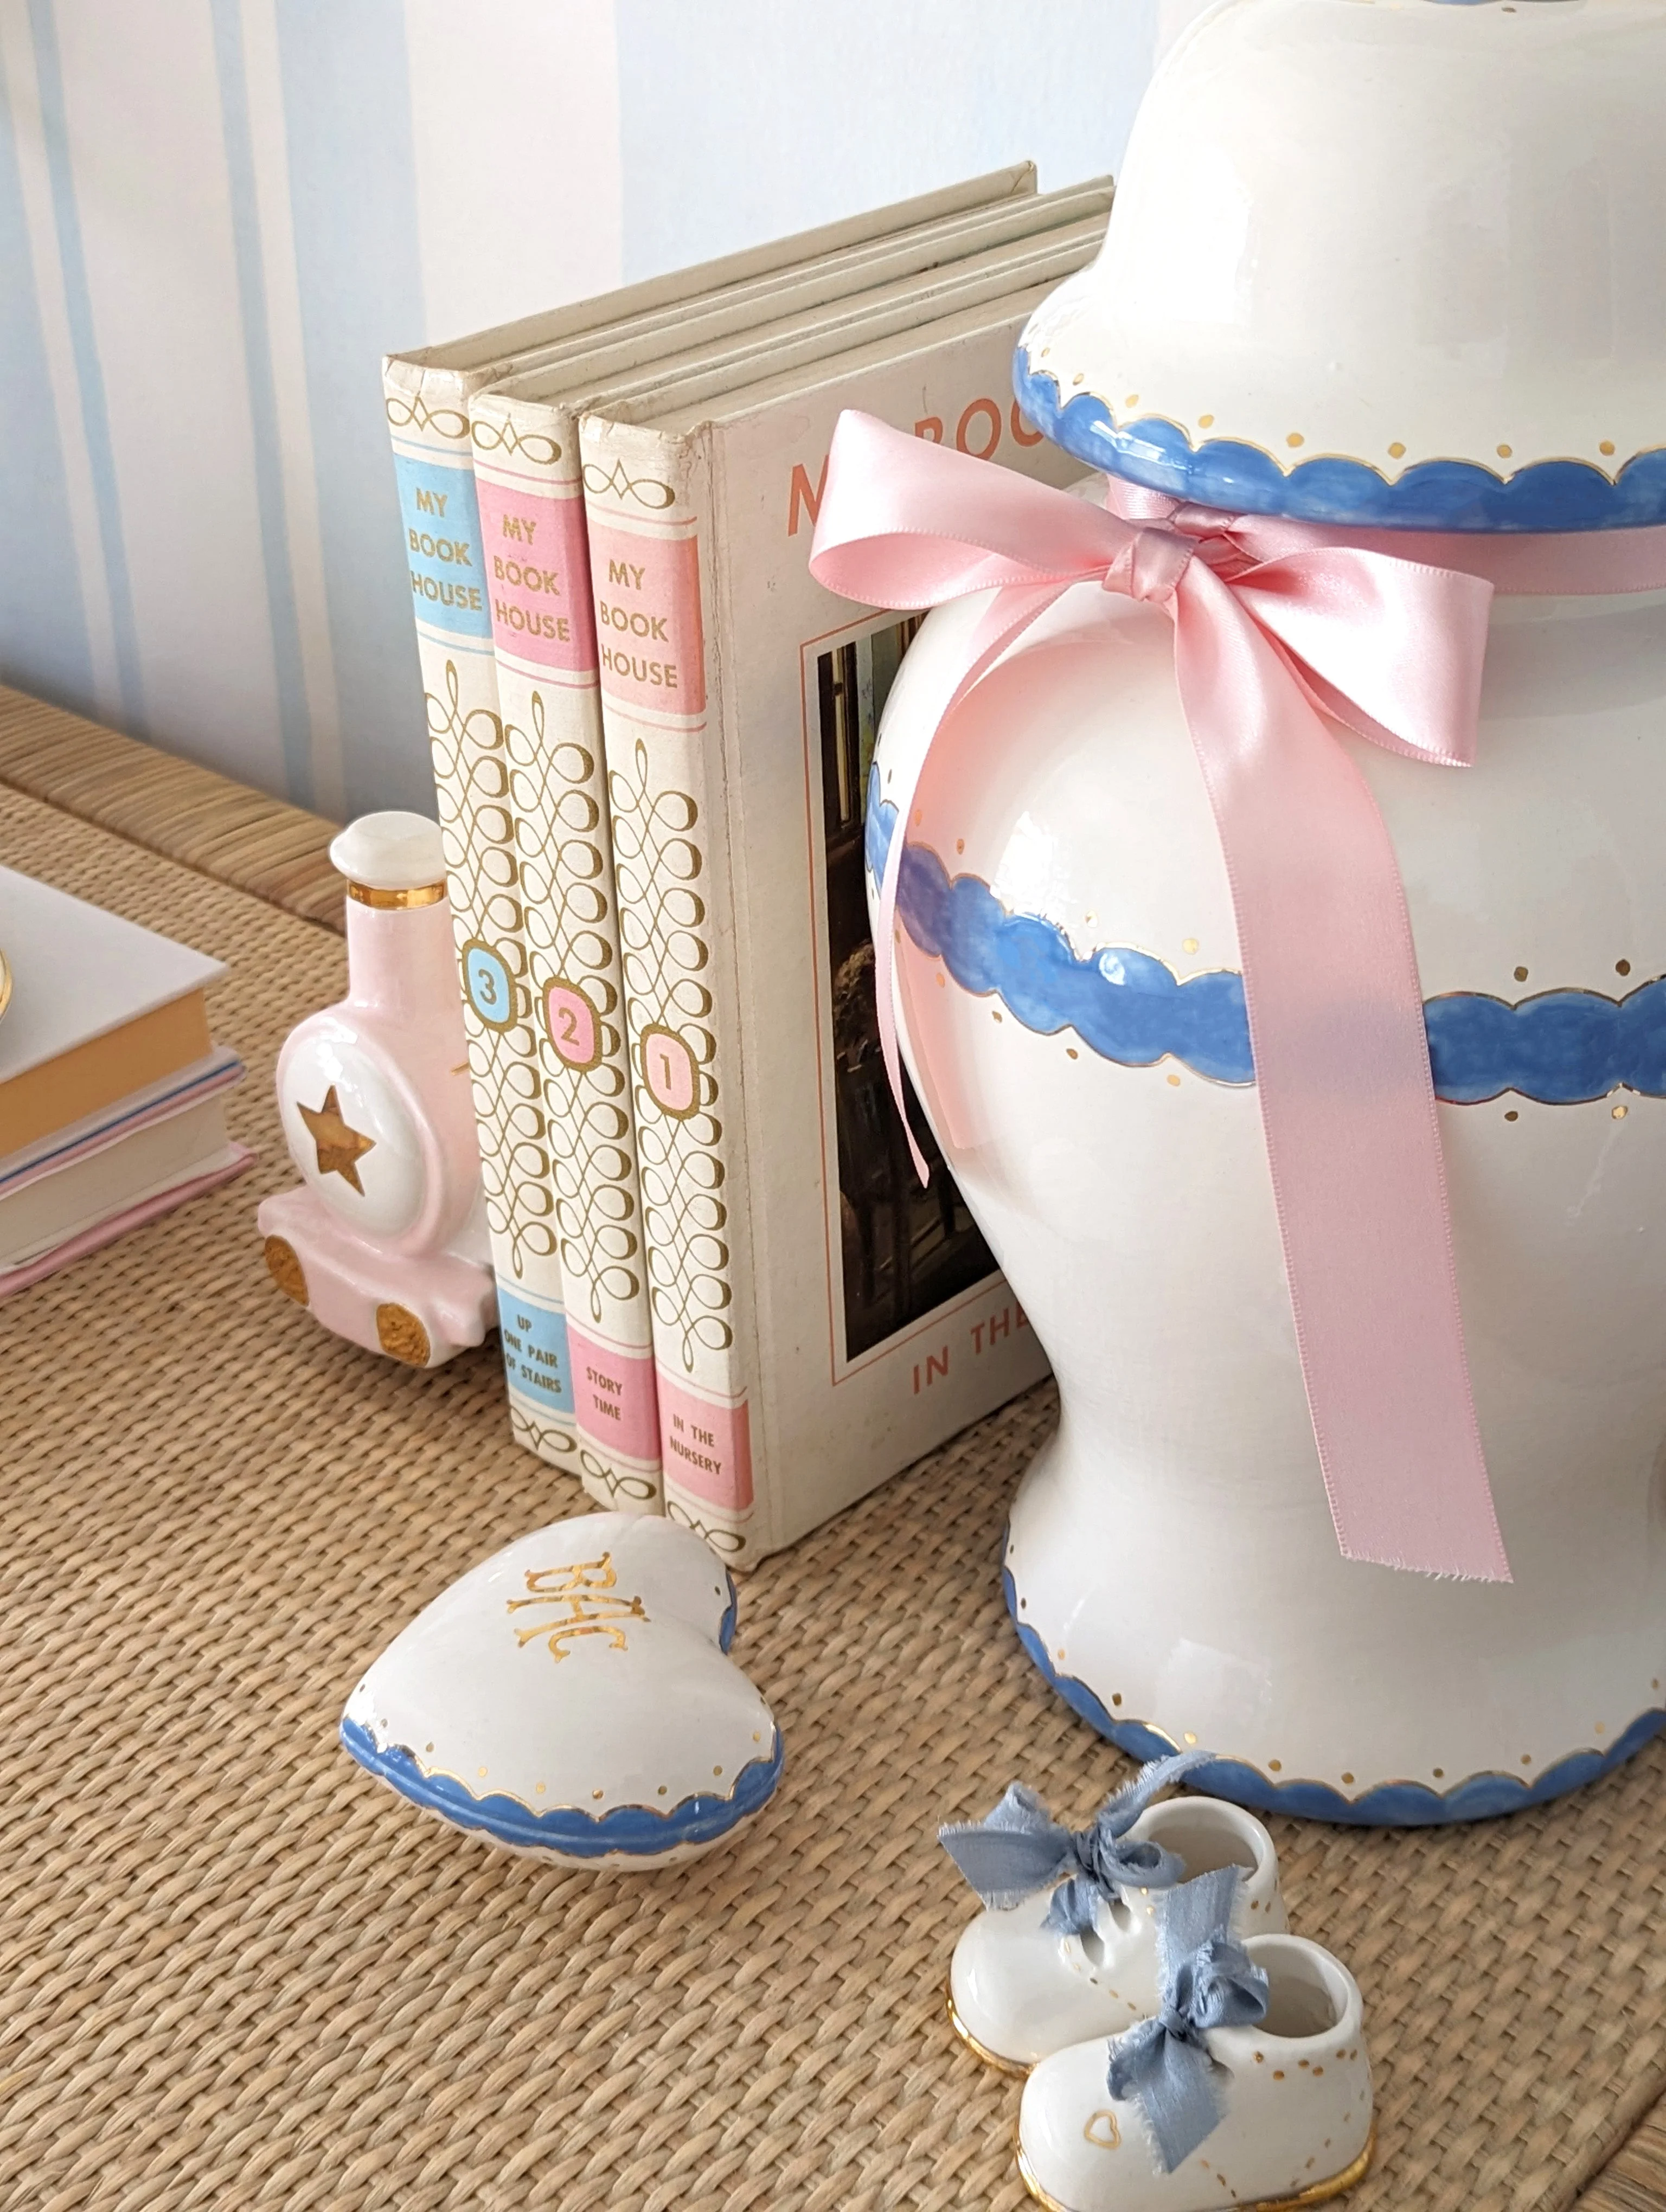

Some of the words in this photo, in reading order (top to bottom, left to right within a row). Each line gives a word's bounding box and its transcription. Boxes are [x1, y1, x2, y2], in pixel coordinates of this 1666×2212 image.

[416, 488, 447, 517] MY
[409, 529, 472, 566] BOOK
[503, 515, 536, 545] MY
[411, 571, 482, 611] HOUSE
[494, 556, 560, 595] BOOK
[608, 560, 645, 590] MY
[496, 599, 570, 642] HOUSE
[601, 601, 669, 642] BOOK
[602, 645, 677, 688] HOUSE
[478, 969, 496, 1004] 3
[559, 1007, 579, 1046] 2
[659, 1054, 671, 1090] 1
[517, 1315, 531, 1332] UP
[504, 1330, 522, 1352] ONE
[528, 1345, 558, 1368] PAIR
[506, 1353, 515, 1369] OF
[521, 1365, 561, 1392] STAIRS
[586, 1367, 622, 1396] STORY
[913, 1346, 947, 1394] IN
[593, 1394, 620, 1420] TIME
[673, 1414, 684, 1432] IN
[691, 1425, 714, 1447] THE
[670, 1436, 721, 1475] NURSERY
